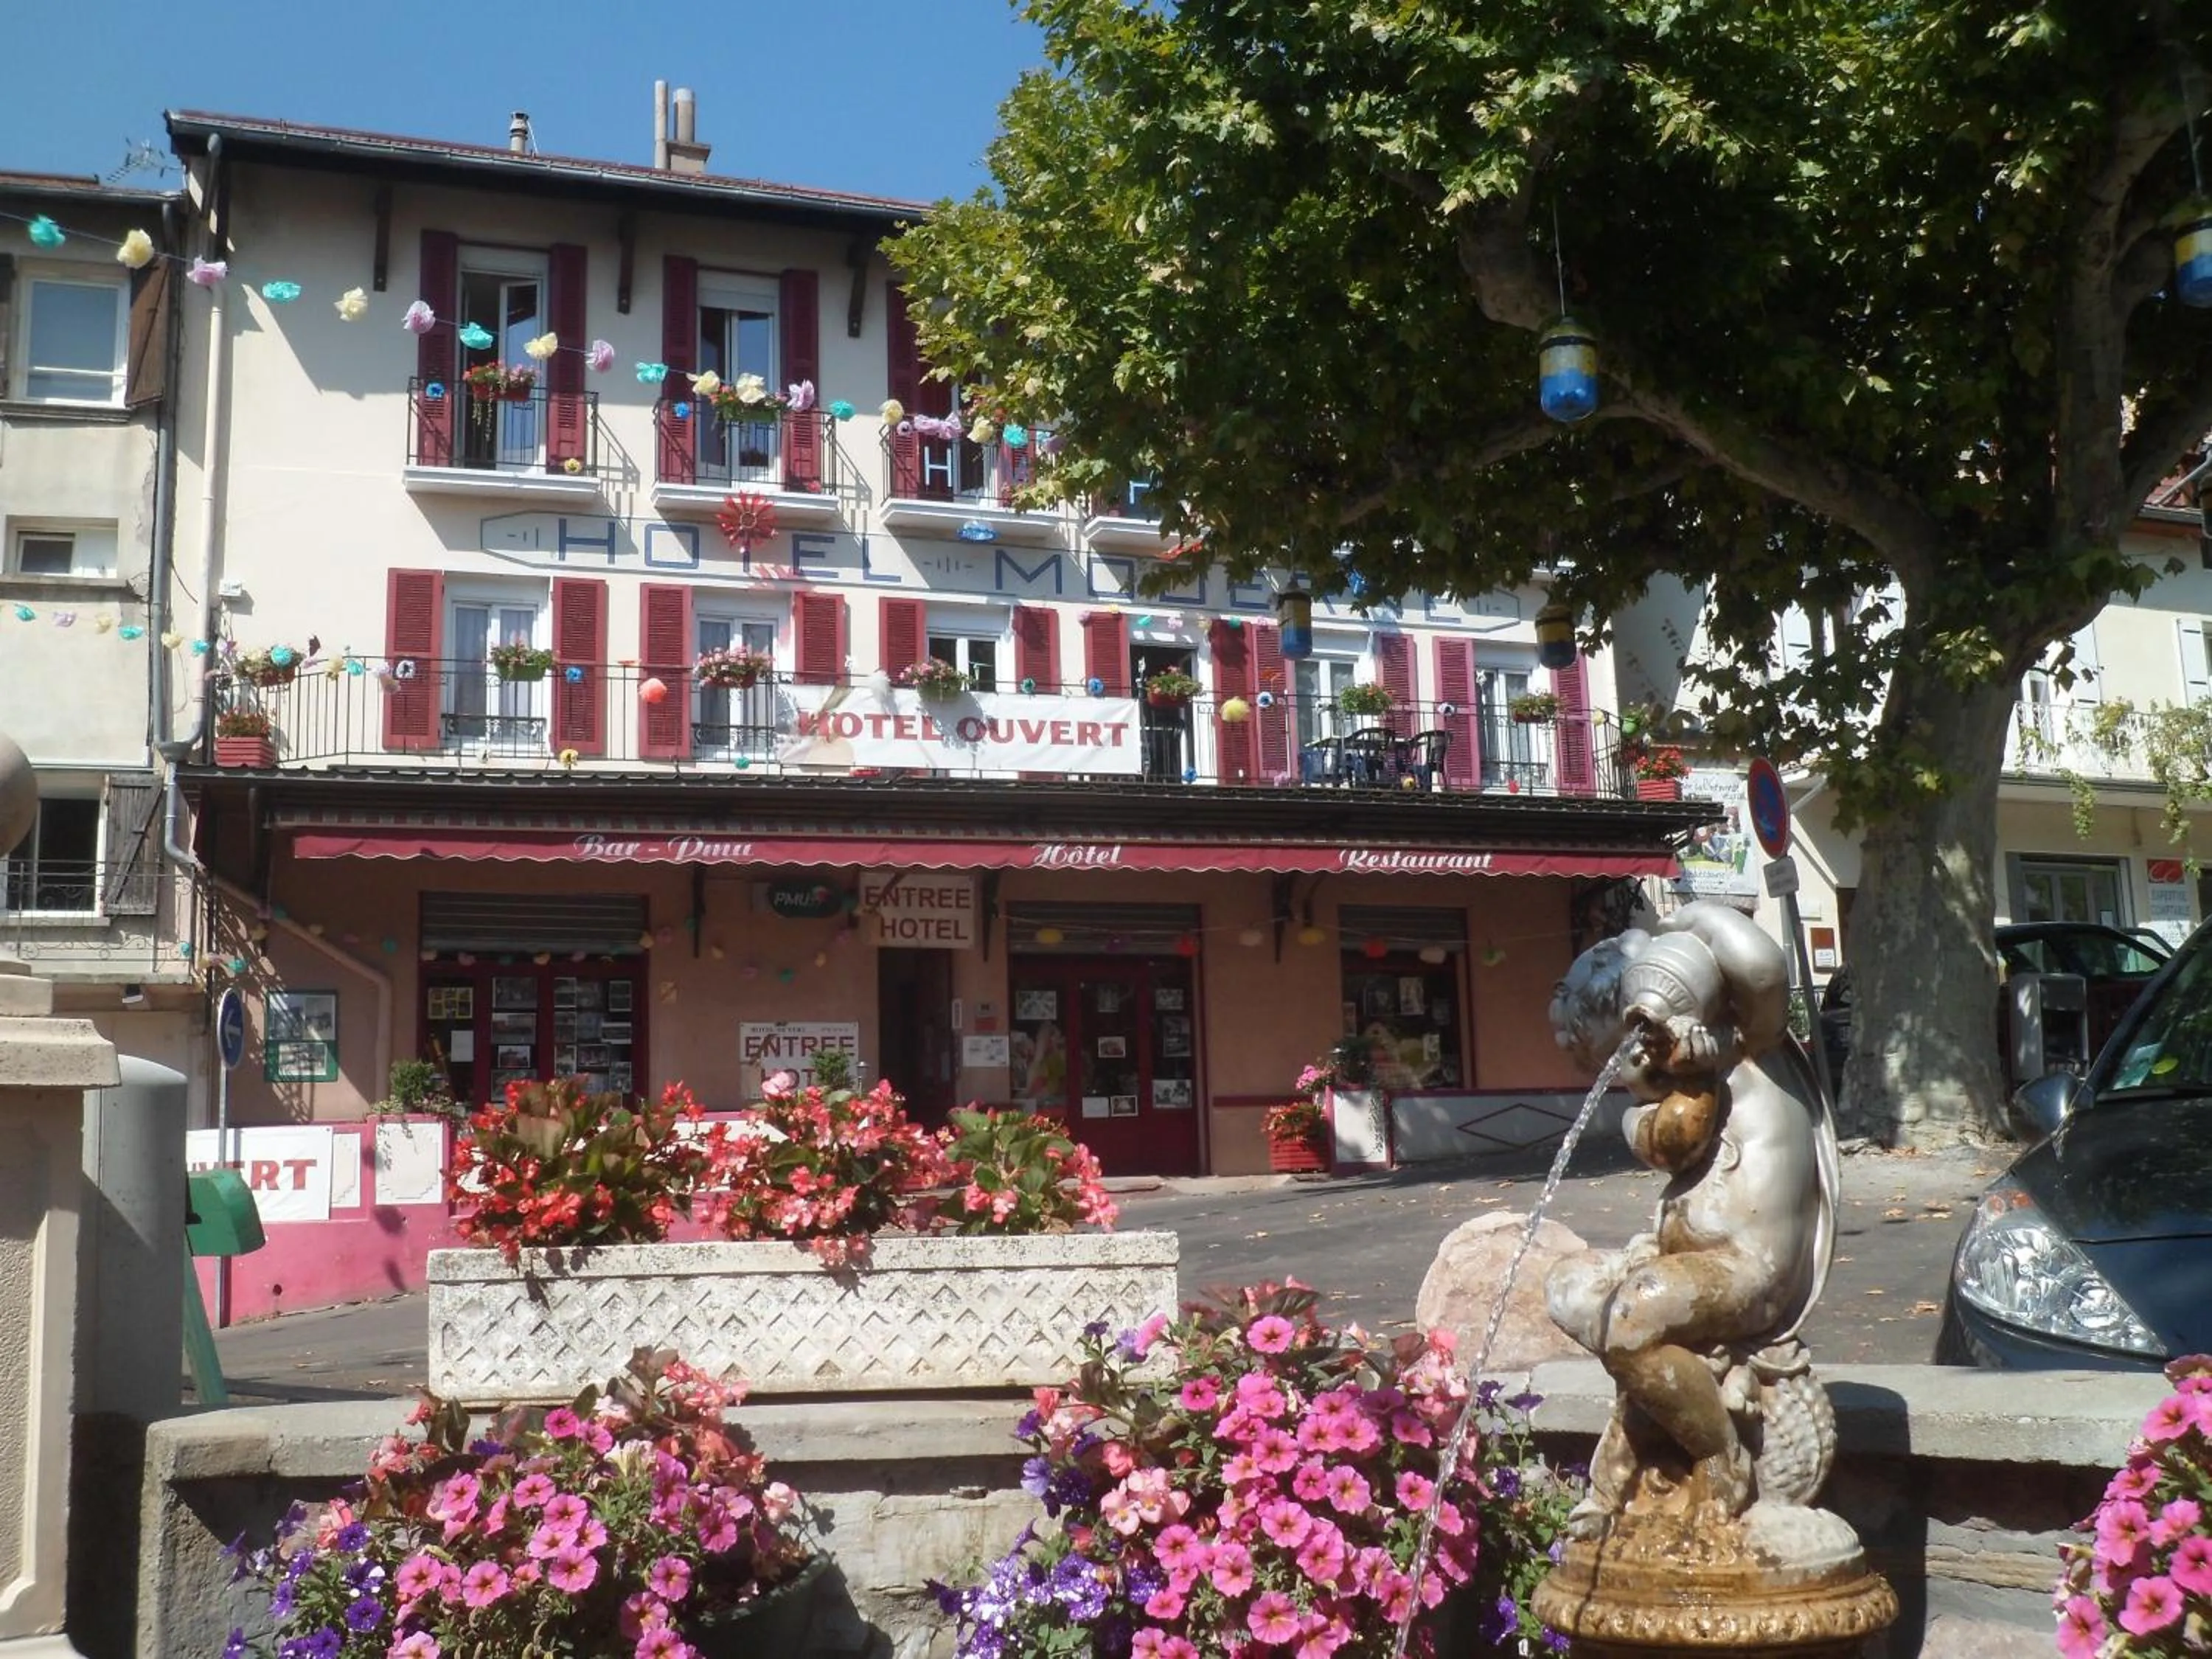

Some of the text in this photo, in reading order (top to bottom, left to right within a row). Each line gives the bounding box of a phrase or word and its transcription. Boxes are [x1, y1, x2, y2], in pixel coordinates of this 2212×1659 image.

[799, 708, 1129, 747] HOTEL OUVERT
[574, 834, 640, 856] Bar
[667, 835, 754, 861] Pmu
[1032, 843, 1121, 864] Hôtel
[1339, 849, 1492, 868] Restaurant
[774, 892, 809, 906] PMU
[864, 886, 971, 909] ENTREE
[880, 918, 969, 940] HOTEL
